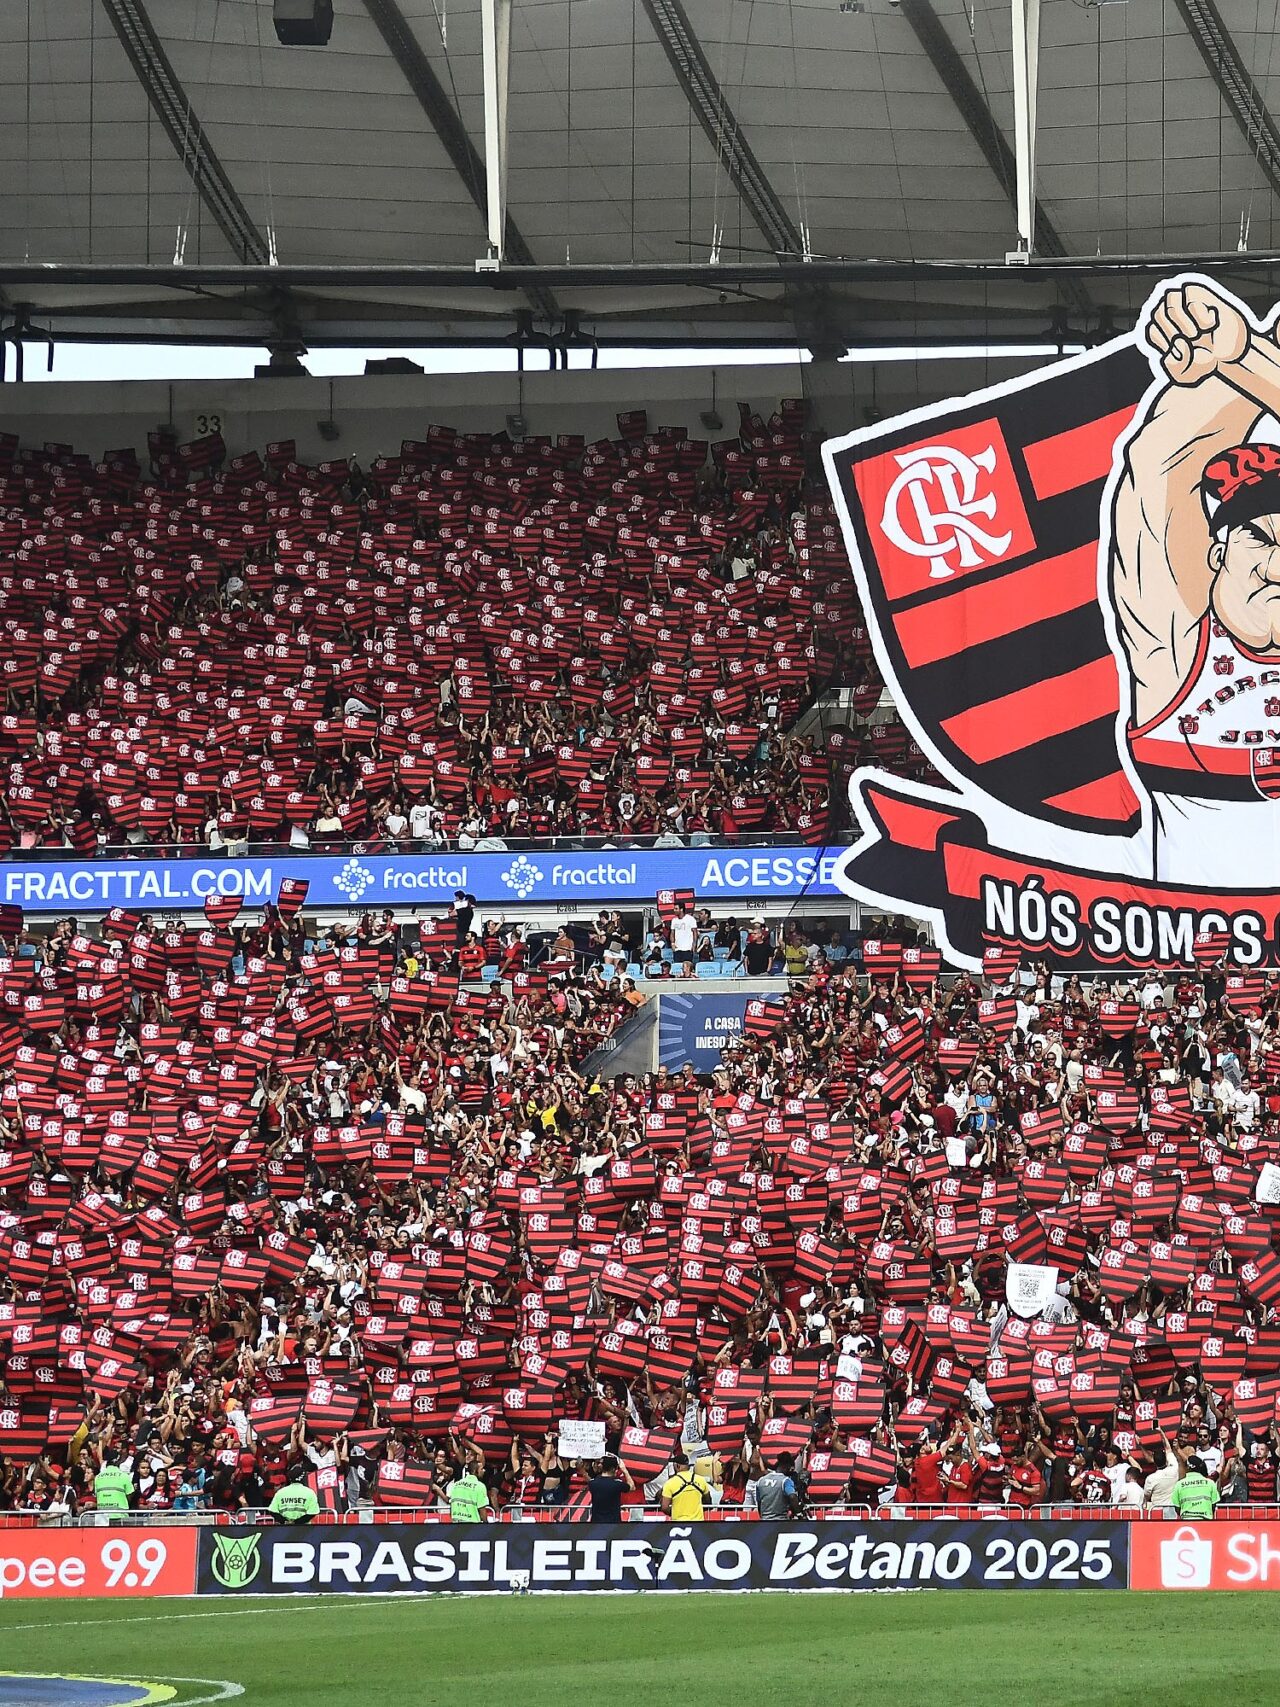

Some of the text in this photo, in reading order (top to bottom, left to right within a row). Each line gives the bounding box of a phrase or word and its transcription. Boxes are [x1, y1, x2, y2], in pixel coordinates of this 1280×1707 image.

[197, 415, 221, 434] 33
[6, 868, 272, 901] FRACTTAL.COM
[383, 866, 467, 887] fracttal
[552, 864, 636, 884] fracttal
[984, 879, 1077, 947] NÓS
[704, 1016, 741, 1030] A CASA
[280, 1497, 306, 1505] SUNSET
[101, 1539, 167, 1587] 9.9
[271, 1527, 1113, 1582] BRASILEIRÃO Betano 2025
